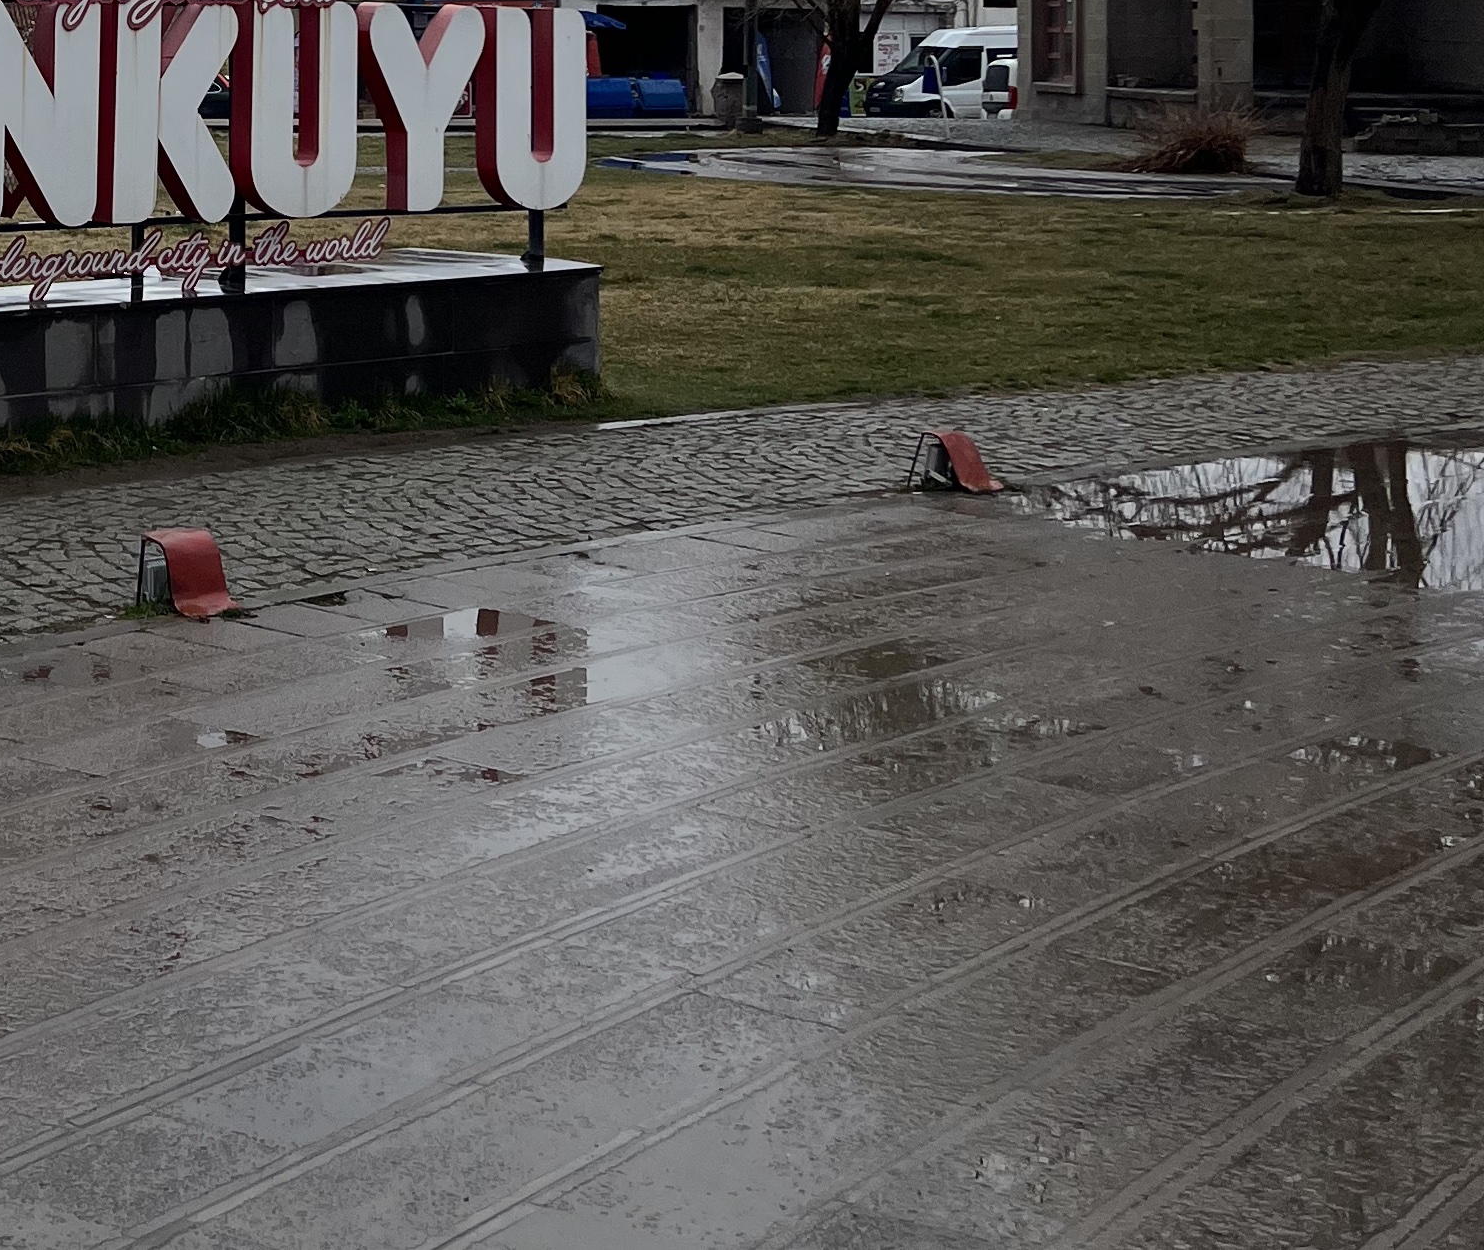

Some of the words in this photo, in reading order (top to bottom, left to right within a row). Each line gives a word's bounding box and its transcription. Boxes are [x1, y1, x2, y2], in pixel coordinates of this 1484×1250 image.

[157, 232, 210, 290] city
[217, 238, 246, 265] in
[253, 221, 299, 264] the
[305, 217, 382, 261] world
